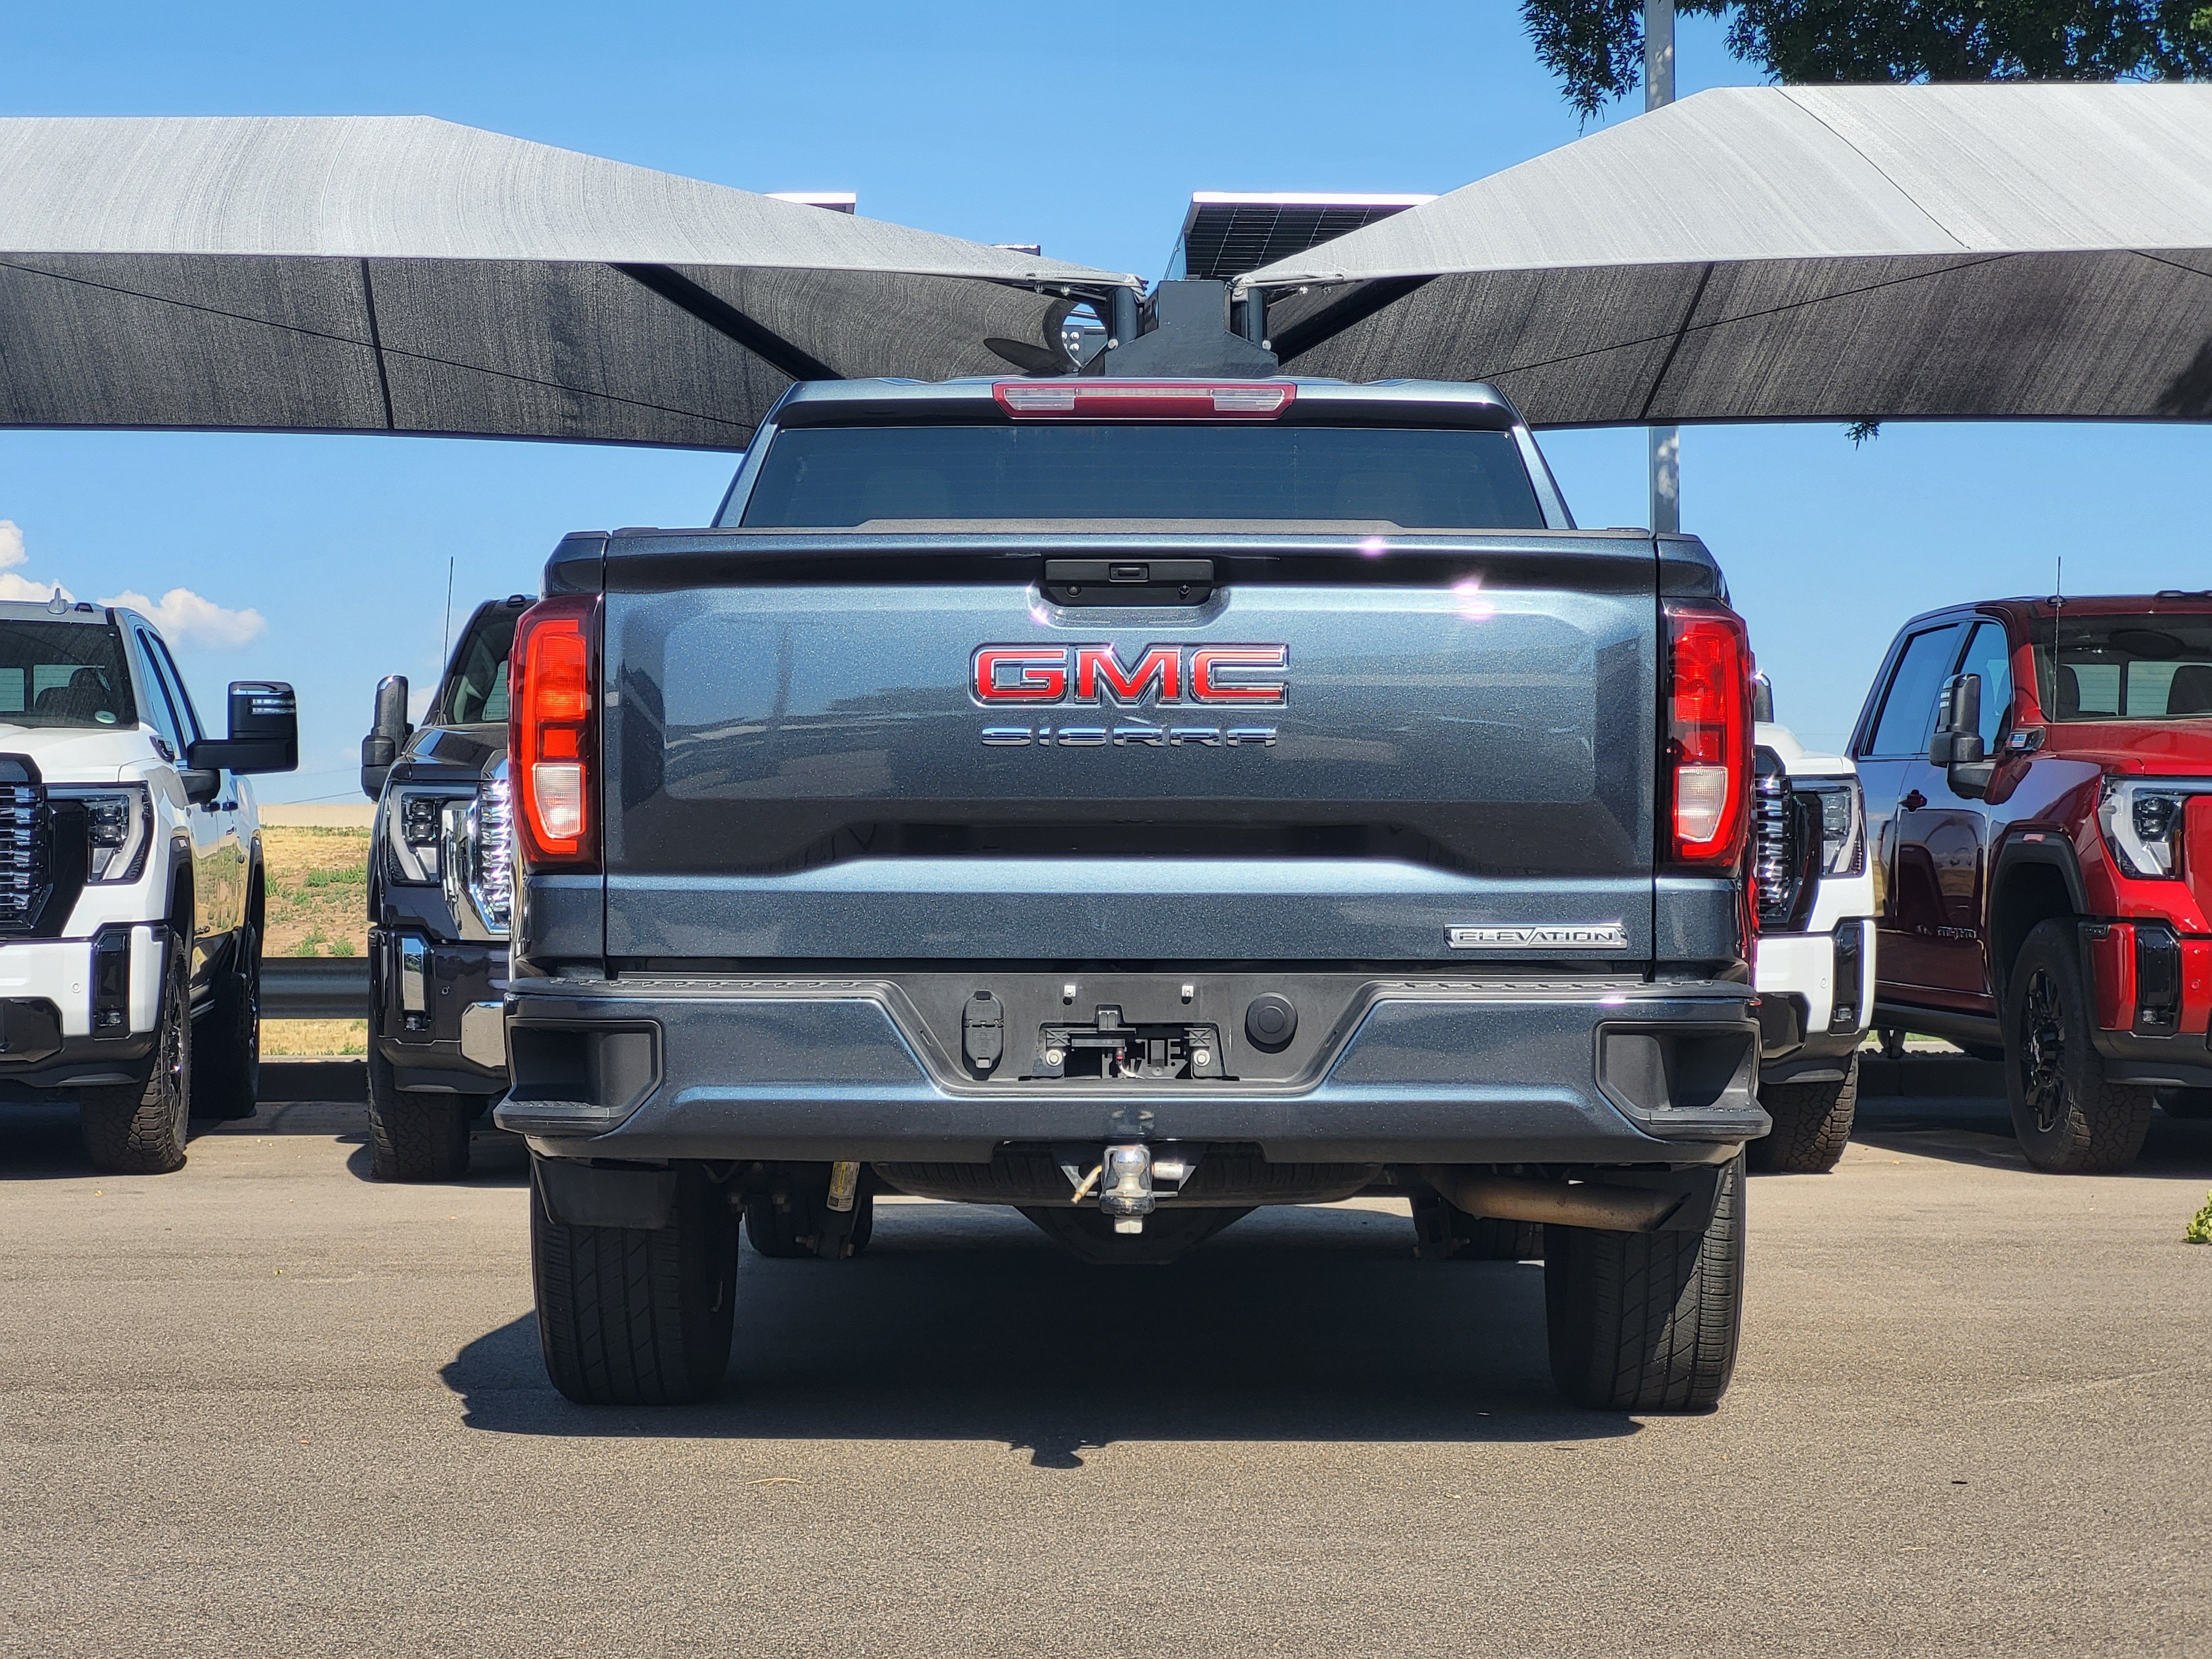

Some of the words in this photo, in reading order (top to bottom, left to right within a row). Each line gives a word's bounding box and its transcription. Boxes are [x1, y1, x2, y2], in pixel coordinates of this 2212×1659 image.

[972, 644, 1288, 707] GMC
[981, 728, 1276, 747] SIERRA
[1459, 931, 1613, 942] ELEVATION
